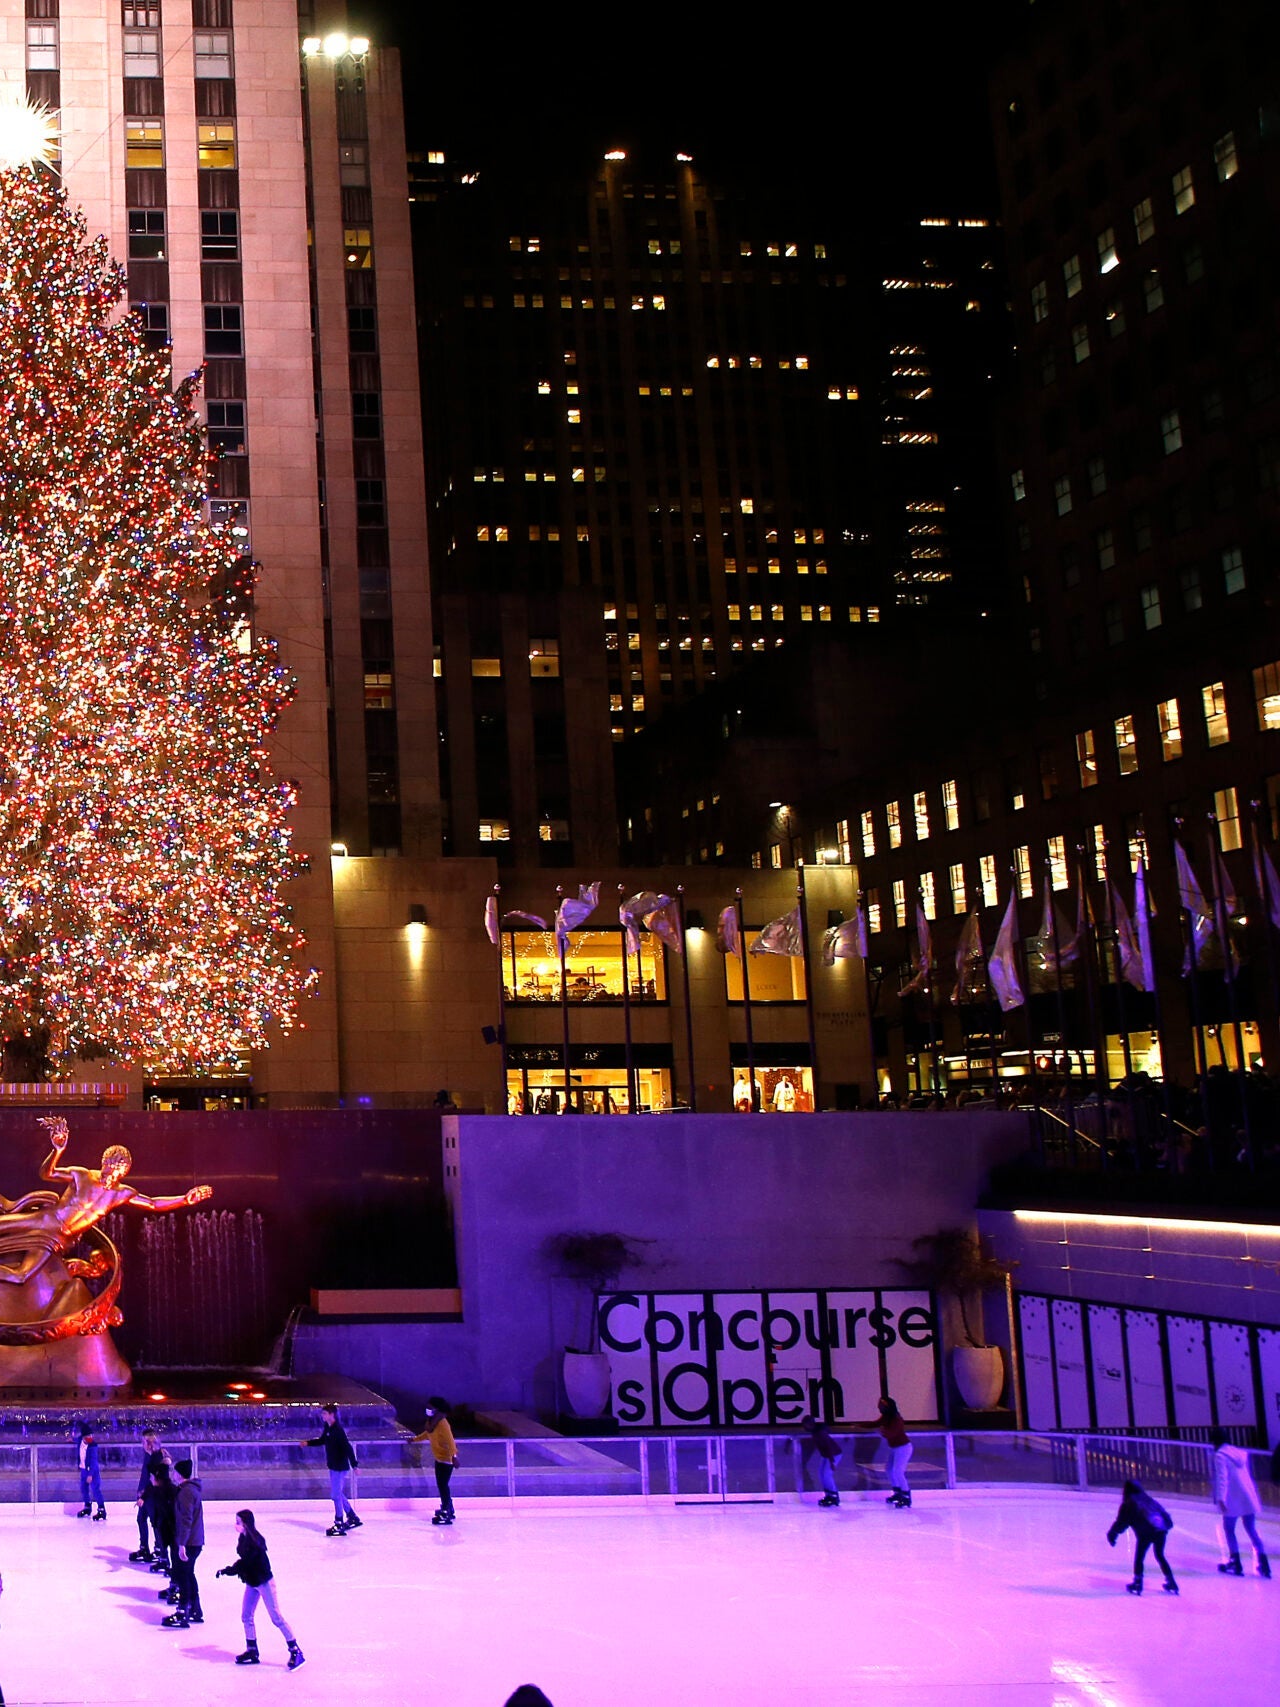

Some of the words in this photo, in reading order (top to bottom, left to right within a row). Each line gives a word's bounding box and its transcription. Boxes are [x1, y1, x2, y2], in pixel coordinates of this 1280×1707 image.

[599, 1295, 935, 1353] Concourse
[610, 1370, 646, 1422] s
[662, 1362, 845, 1424] Open
